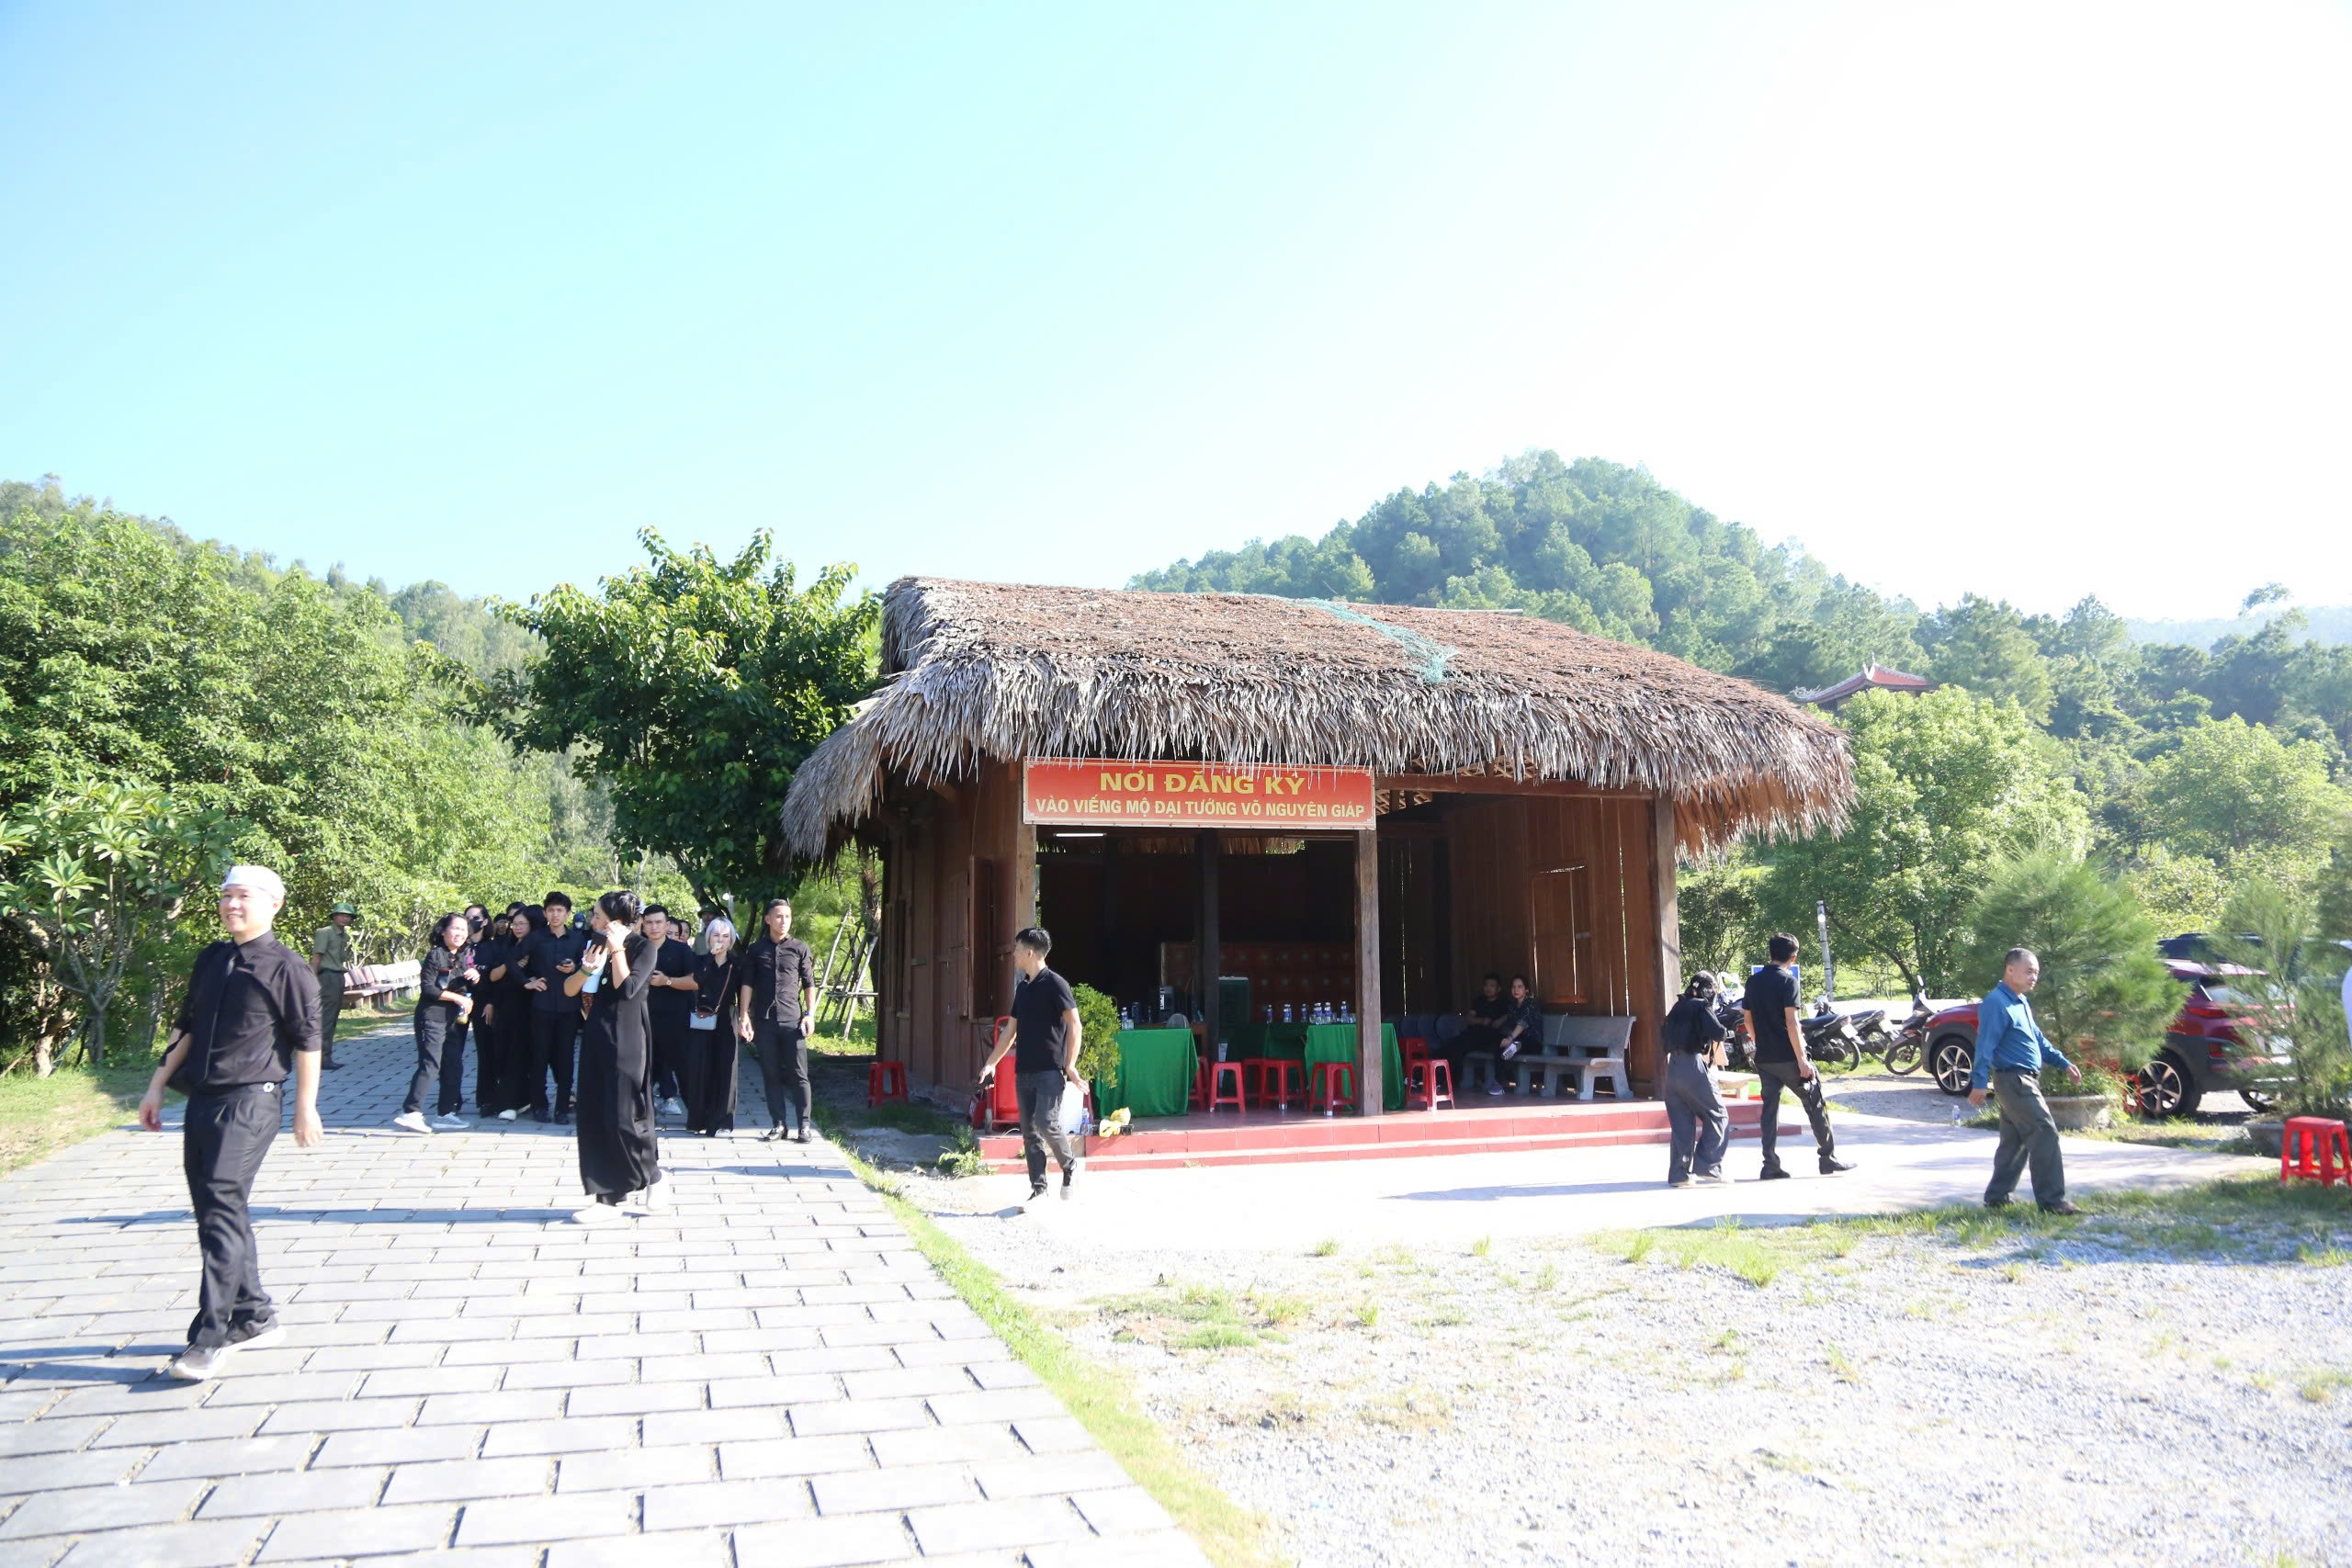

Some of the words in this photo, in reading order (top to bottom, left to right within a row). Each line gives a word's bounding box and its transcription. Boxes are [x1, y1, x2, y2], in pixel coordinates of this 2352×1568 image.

[1101, 770, 1154, 792] NƠI
[1164, 770, 1254, 795] ĐĂNG
[1035, 795, 1069, 813] VÀO
[1074, 795, 1122, 814] VIẾNG
[1126, 797, 1150, 818] MỘ
[1154, 800, 1182, 818] ĐẠI
[1185, 798, 1237, 816] TƯỚNG
[1241, 799, 1261, 817] VÕ
[1266, 801, 1328, 818] NGUYÊN
[1330, 801, 1365, 818] GIÁP
